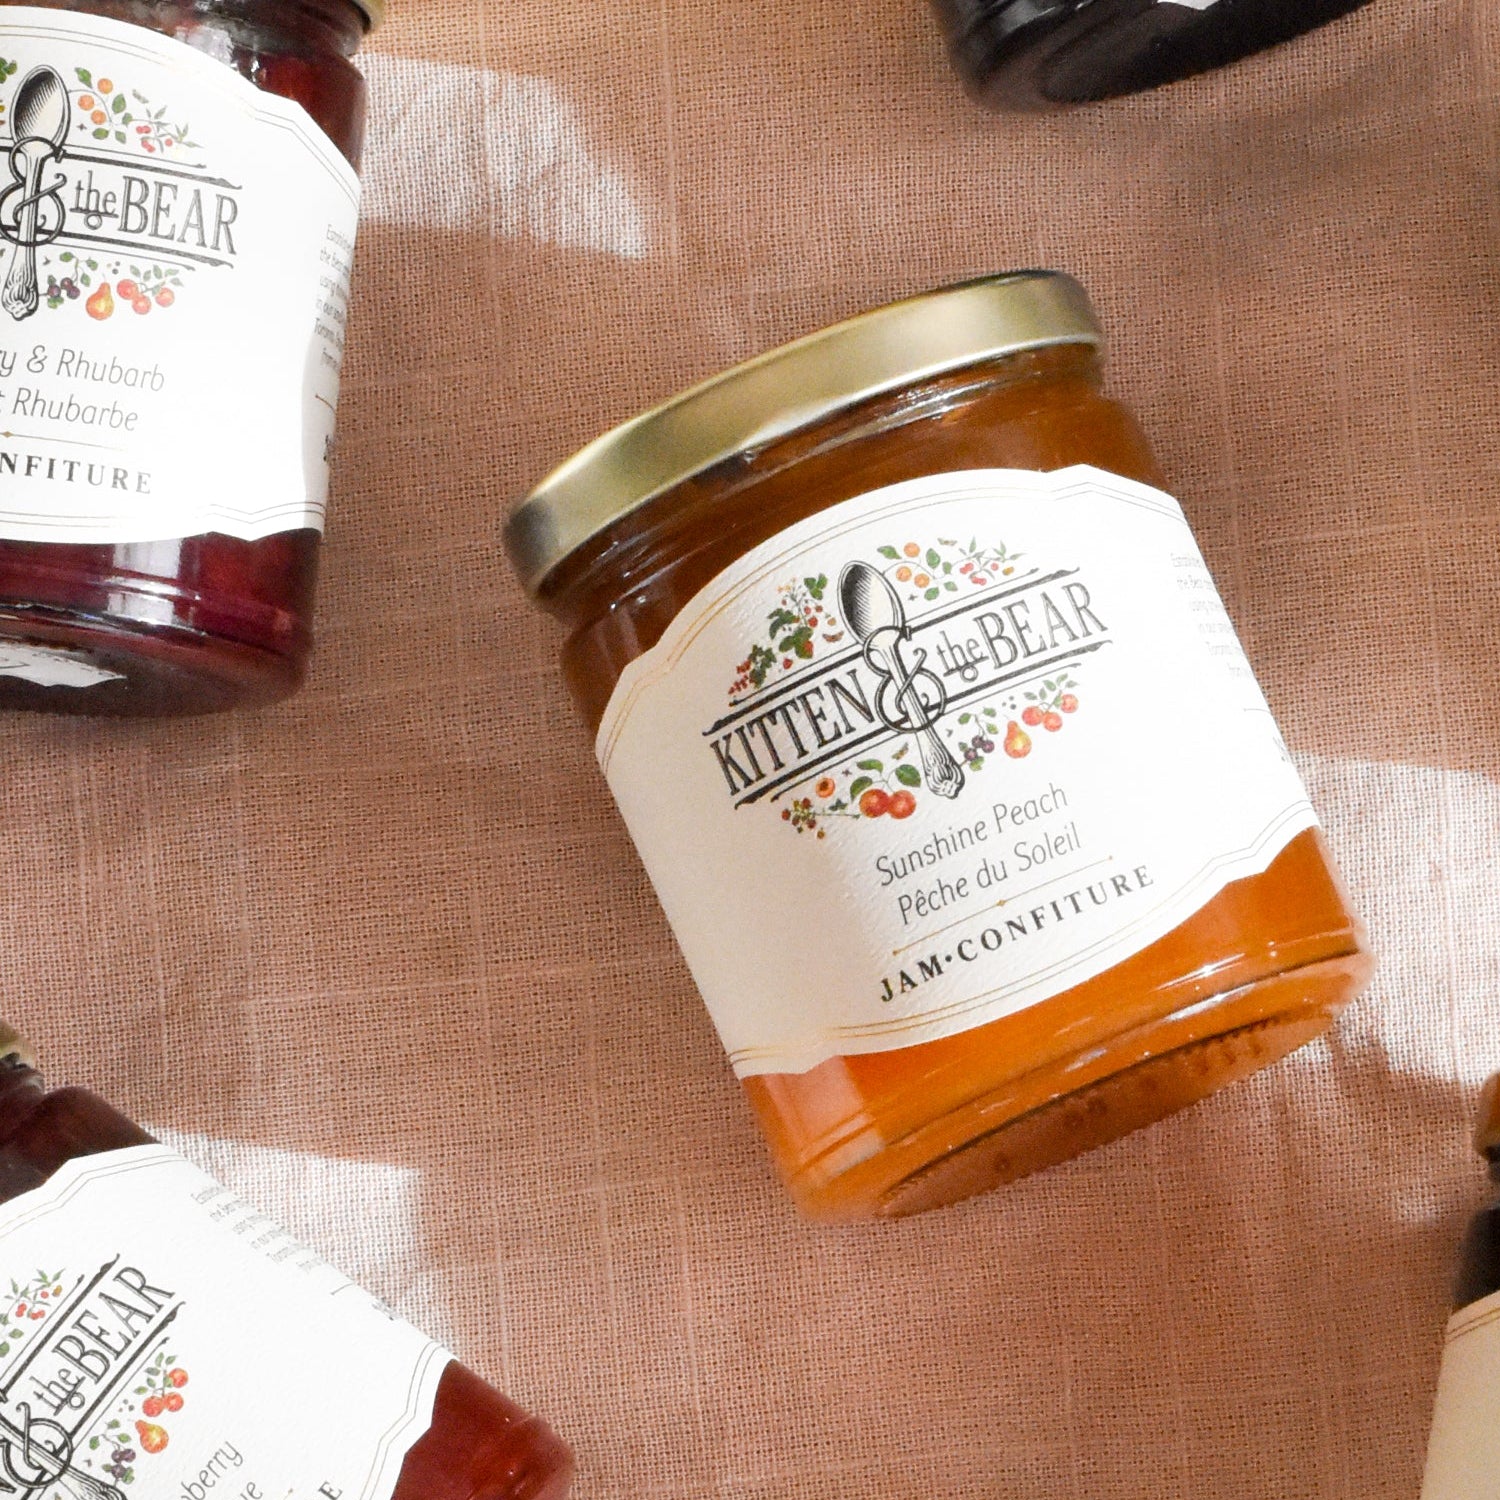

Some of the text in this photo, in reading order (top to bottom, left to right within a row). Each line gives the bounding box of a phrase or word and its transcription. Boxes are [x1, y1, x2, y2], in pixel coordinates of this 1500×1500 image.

[118, 174, 239, 256] BEAR
[12, 387, 139, 431] Rhubarbe
[26, 344, 48, 374] &
[56, 348, 165, 392] Rhubarb
[709, 670, 876, 796] KITTEN
[934, 633, 989, 682] the
[983, 582, 1108, 674] BEAR
[875, 782, 1068, 887] Sunshine Peach
[897, 821, 1081, 926] Pêche du Soleil
[51, 1266, 176, 1386] BEAR
